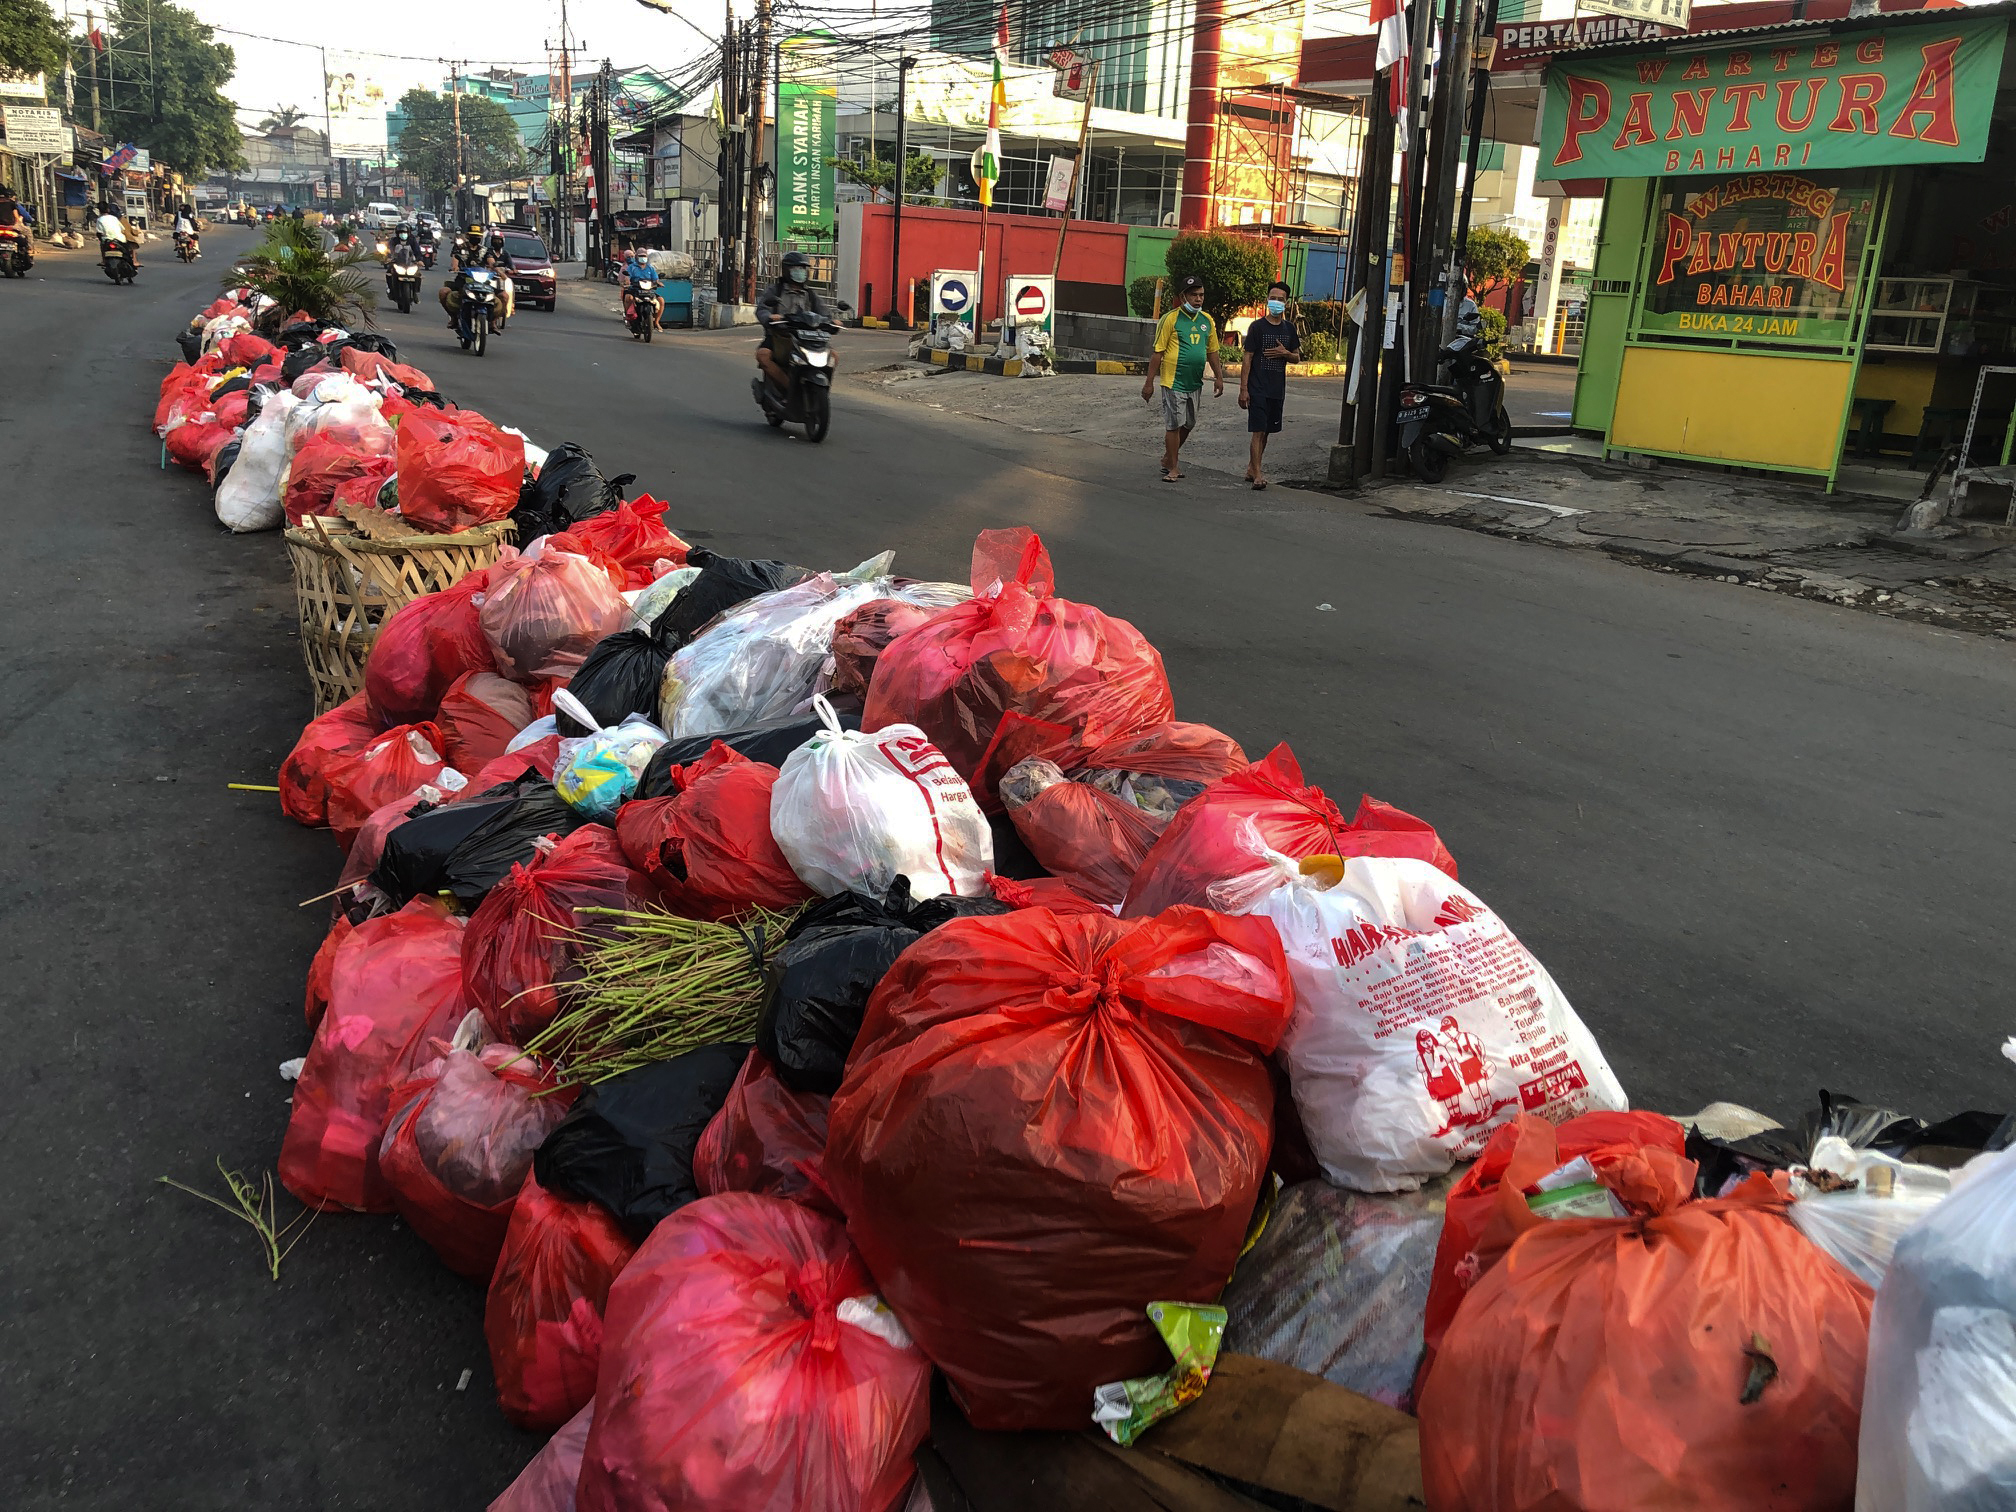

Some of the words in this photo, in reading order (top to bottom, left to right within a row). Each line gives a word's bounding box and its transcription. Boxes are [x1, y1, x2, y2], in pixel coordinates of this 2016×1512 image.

[1503, 18, 1661, 49] PERTAMINA
[1051, 52, 1068, 68] PAS!
[1636, 37, 1885, 84] WARTEG
[1553, 37, 1962, 166] PANTURA
[793, 98, 808, 166] SYARIAH
[812, 100, 822, 147] KARIMAH
[811, 151, 822, 181] INSAN
[1665, 142, 1811, 172] BAHARI
[793, 171, 808, 215] BANK
[811, 183, 821, 216] HARTA
[1688, 174, 1835, 219] WARTEG
[1657, 211, 1851, 291] PANTURA
[1697, 283, 1794, 309] BAHARI
[1189, 333, 1201, 345] 17
[1679, 313, 1728, 331] BUKA
[1732, 316, 1753, 333] 24
[1758, 318, 1798, 336] JAM
[941, 792, 967, 802] Harga
[1367, 974, 1404, 992] Seragam
[1405, 960, 1437, 977] Sekolah
[1404, 956, 1420, 969] Jual
[1358, 999, 1372, 1008] Bh,
[1373, 990, 1392, 1001] Baju
[1393, 979, 1420, 993] Dalam
[1420, 967, 1449, 981] Wanita
[1368, 1000, 1394, 1013] koper,
[1396, 986, 1423, 1003] gesper
[1425, 973, 1460, 989] Sekolah,
[1381, 996, 1422, 1016] Peralatan
[1423, 983, 1458, 999] Sekolah,
[1498, 986, 1536, 1008] Bahannya
[1374, 1027, 1392, 1039] Baju
[1393, 1014, 1426, 1031] Profesi,
[1426, 1001, 1458, 1017] Kopiah,
[1458, 989, 1490, 1005] Mukena,
[1377, 1012, 1407, 1028] Macam
[1413, 997, 1444, 1013] Macam
[1445, 986, 1475, 1000] Sarung,
[1508, 1053, 1530, 1068] Kita
[1529, 1037, 1558, 1059] Bener2
[1530, 1050, 1569, 1074] Bahannya
[1524, 1064, 1582, 1096] TERIMA
[1549, 1081, 1572, 1098] KJP
